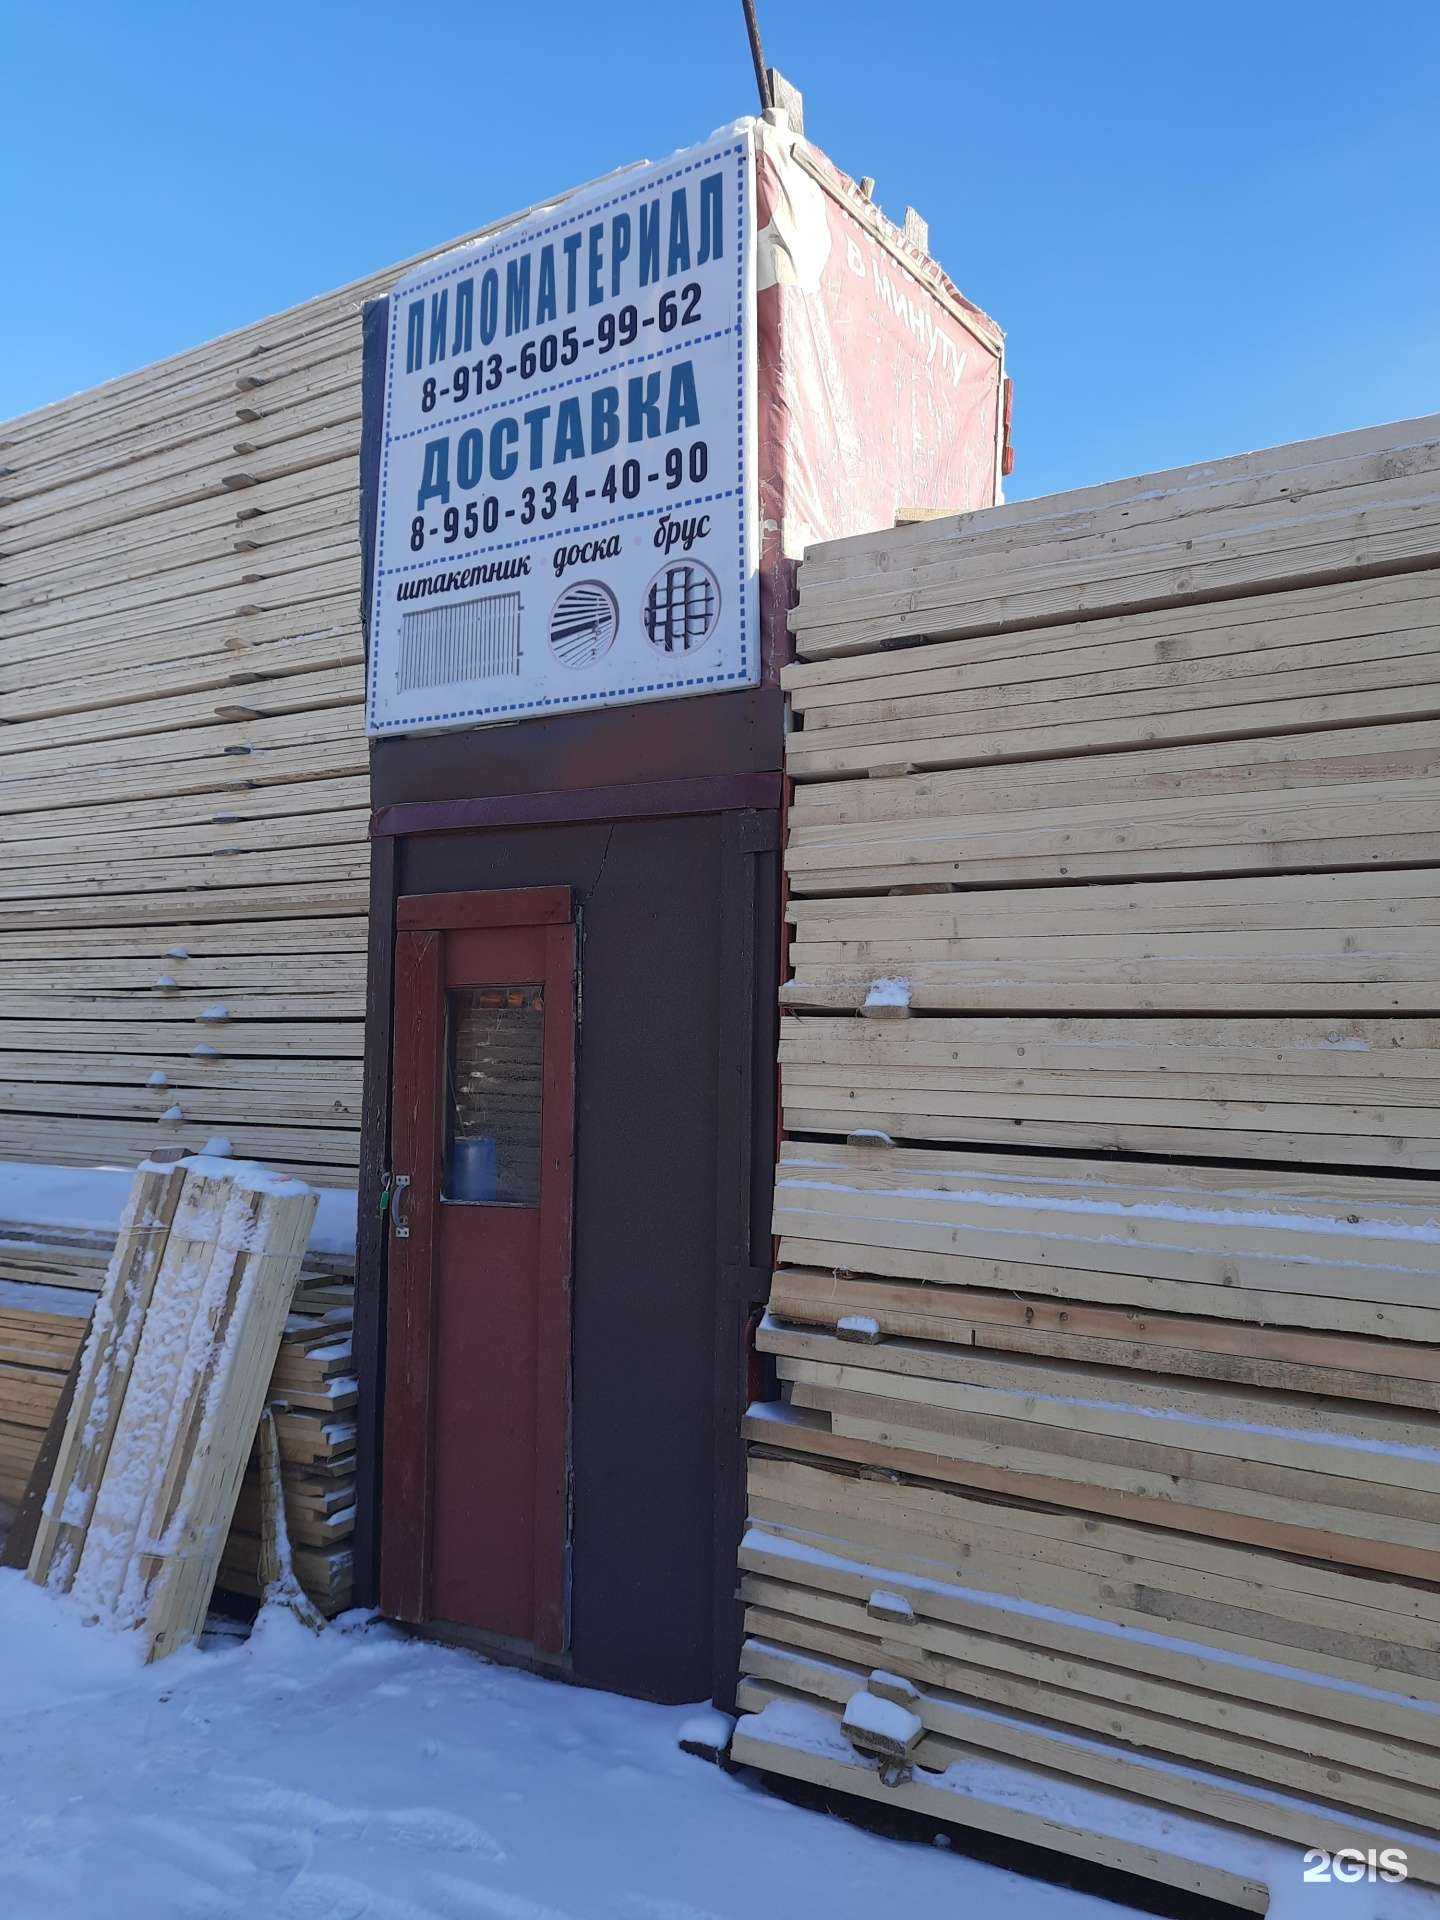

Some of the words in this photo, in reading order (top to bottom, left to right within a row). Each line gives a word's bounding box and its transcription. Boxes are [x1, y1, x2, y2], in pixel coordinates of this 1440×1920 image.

[406, 172, 723, 374] ПИЛОМАТЕРИАЛ
[421, 282, 702, 412] 8-913-605-99-62
[410, 441, 708, 552] 8-950-334-40-90
[417, 360, 700, 511] ДОСТАВКА
[396, 553, 532, 602] штакетник
[553, 534, 622, 577] доска
[653, 512, 711, 555] брус
